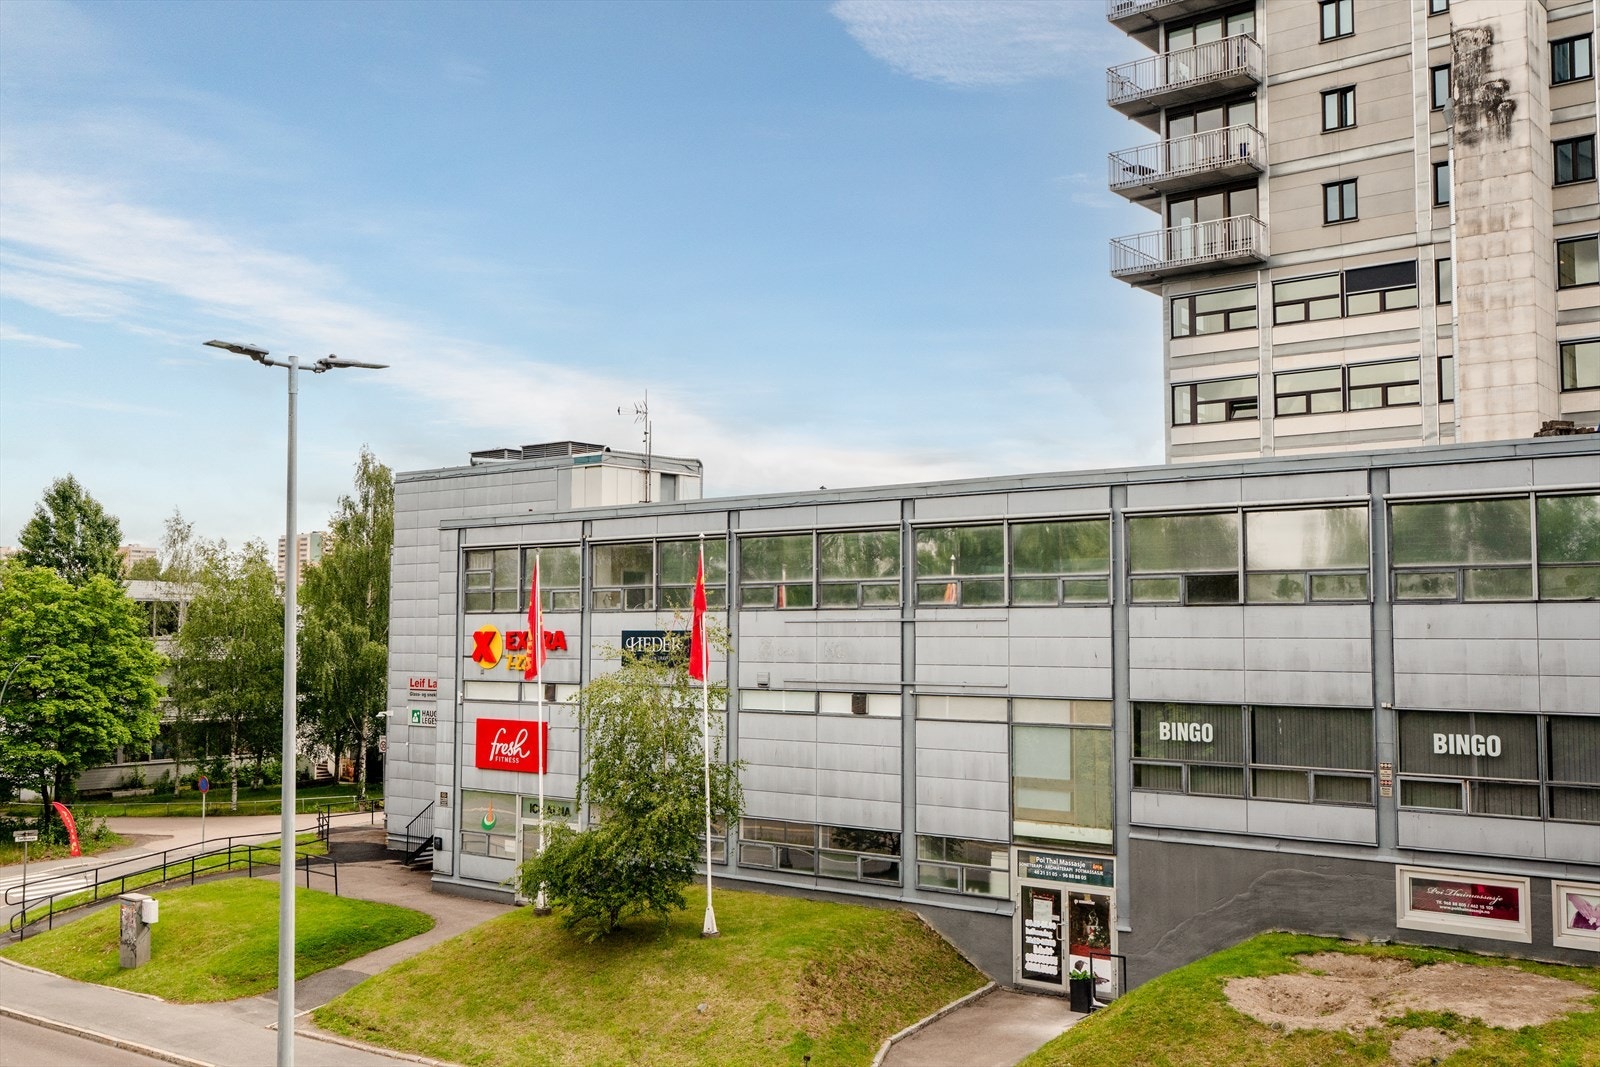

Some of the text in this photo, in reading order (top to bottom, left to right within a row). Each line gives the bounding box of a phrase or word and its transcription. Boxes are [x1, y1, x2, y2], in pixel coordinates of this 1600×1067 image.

[505, 630, 568, 651] EXRA
[410, 678, 426, 688] Leif
[1159, 721, 1213, 743] BINGO
[489, 728, 530, 761] fresh
[1433, 733, 1501, 757] BINGO
[495, 755, 520, 764] FITNESS
[1060, 859, 1086, 869] Massasje
[1446, 889, 1504, 906] Thaimassasje
